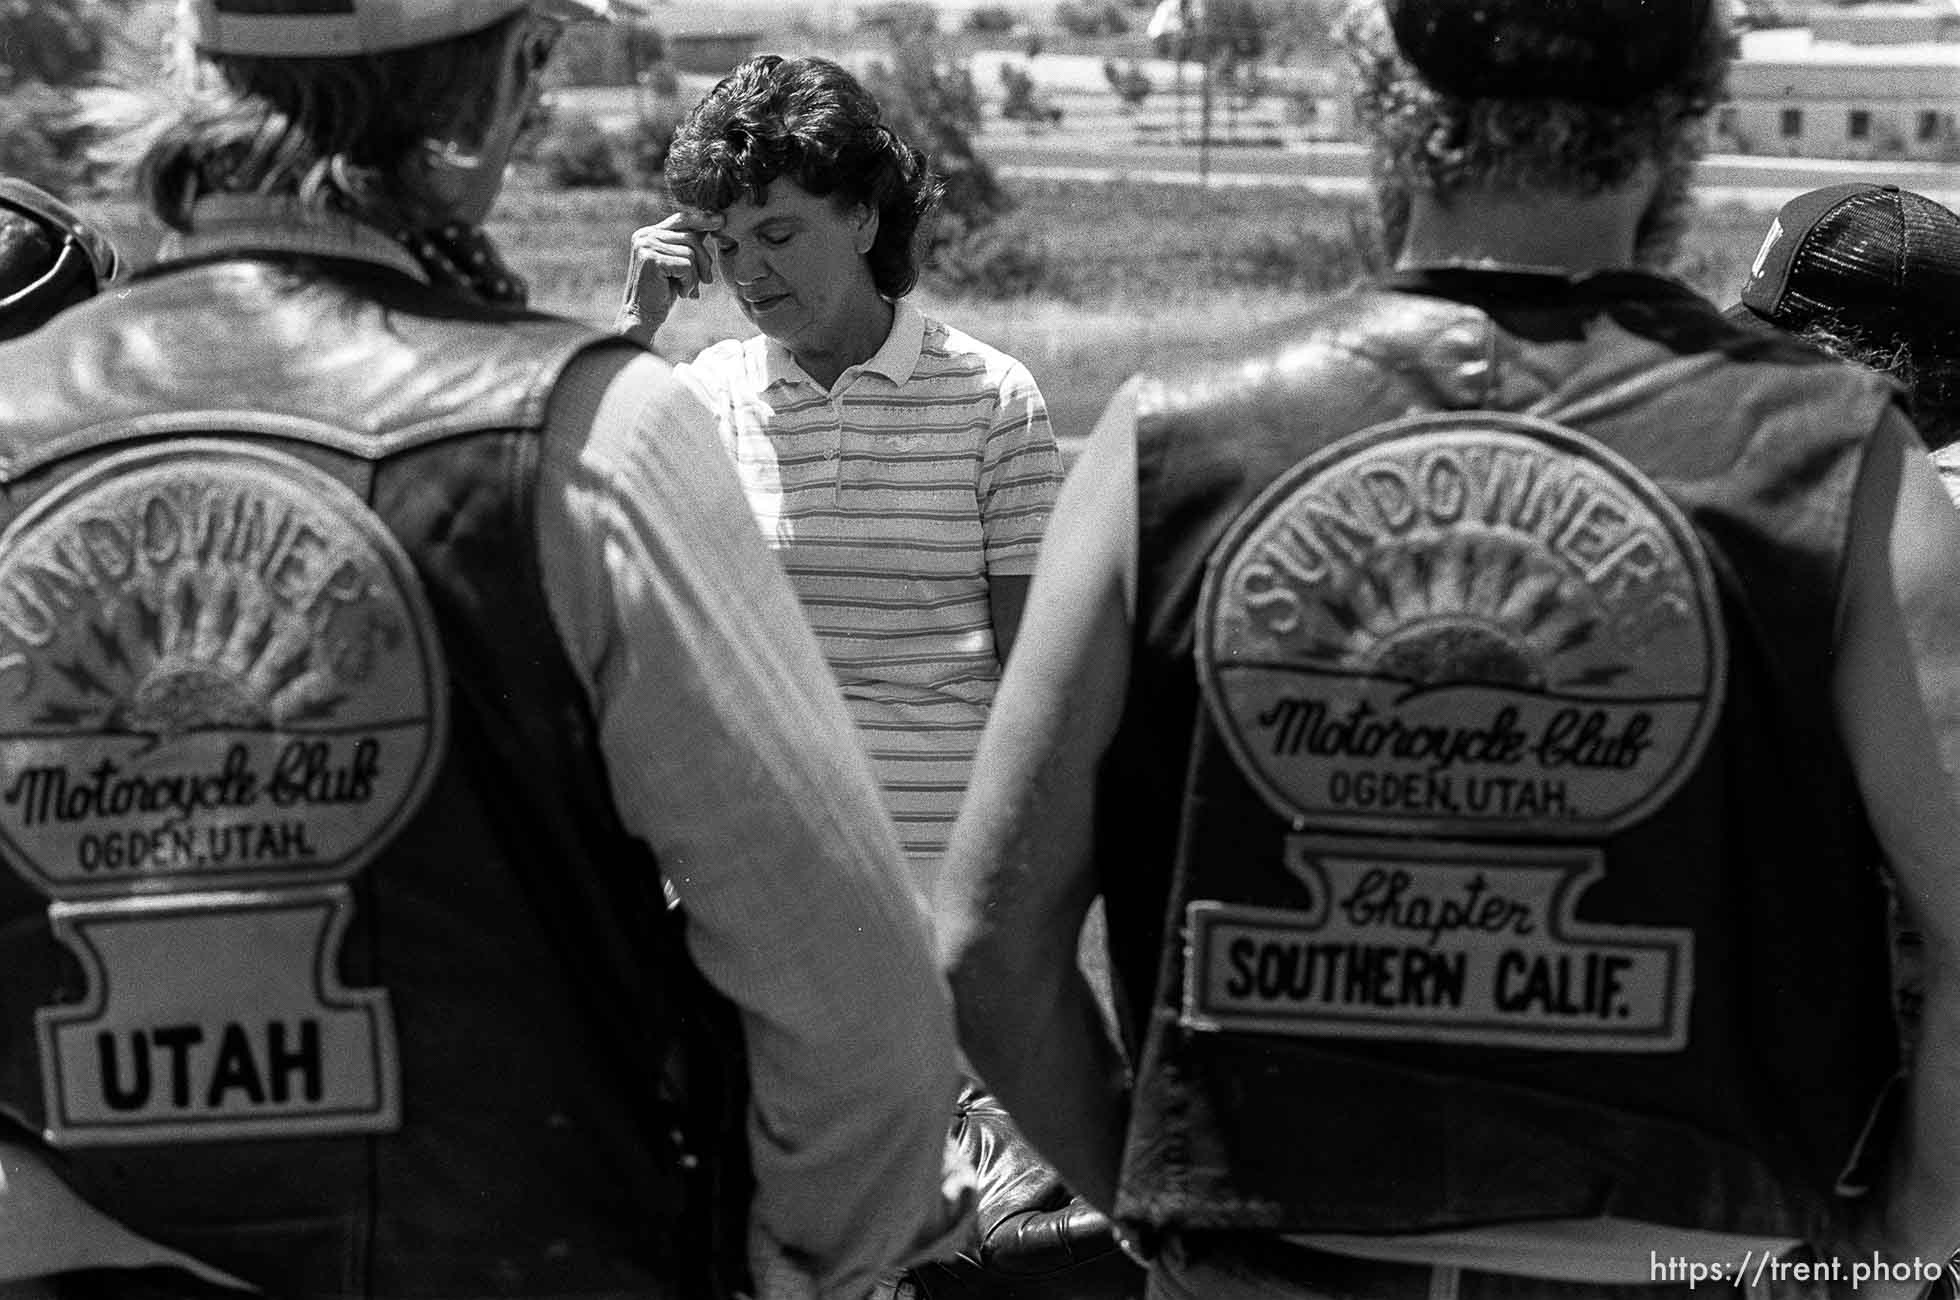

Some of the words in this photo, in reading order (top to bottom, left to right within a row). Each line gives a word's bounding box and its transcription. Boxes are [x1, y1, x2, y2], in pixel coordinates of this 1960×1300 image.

[1258, 697, 1524, 773] Motorcycle
[1530, 708, 1654, 770] Club
[6, 743, 258, 832] Motorcycle
[265, 737, 381, 803] Club
[1341, 868, 1536, 946] Chapter
[1227, 937, 1468, 1009] SOUTHERN
[1492, 949, 1635, 1019] CALIF.
[98, 1019, 323, 1110] UTAH
